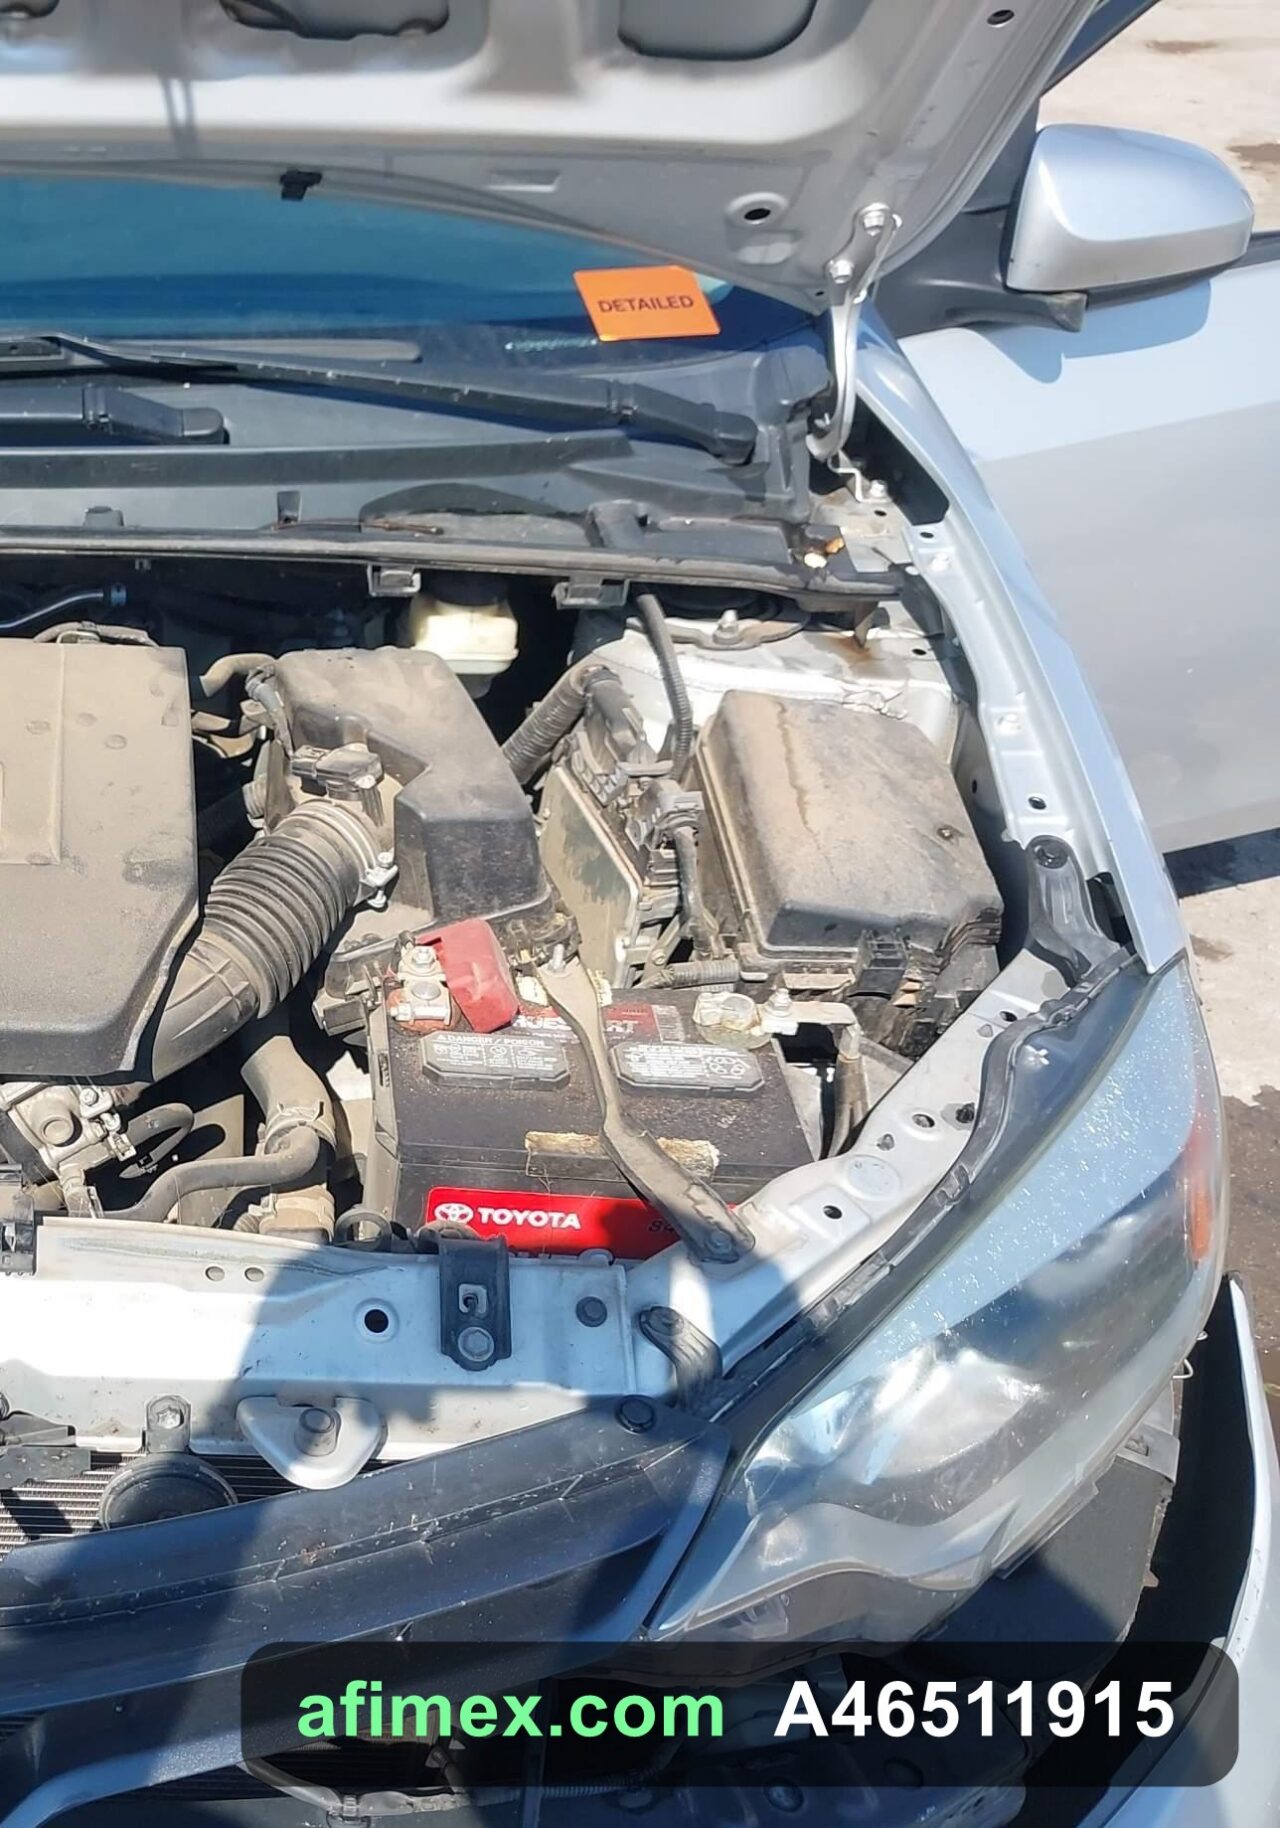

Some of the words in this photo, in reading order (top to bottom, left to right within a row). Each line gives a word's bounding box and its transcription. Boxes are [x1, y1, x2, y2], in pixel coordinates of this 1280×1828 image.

[596, 294, 695, 314] DETAILED
[447, 1034, 493, 1045] DANGER
[503, 1038, 546, 1047] POISON
[477, 1206, 582, 1230] TOYOTA
